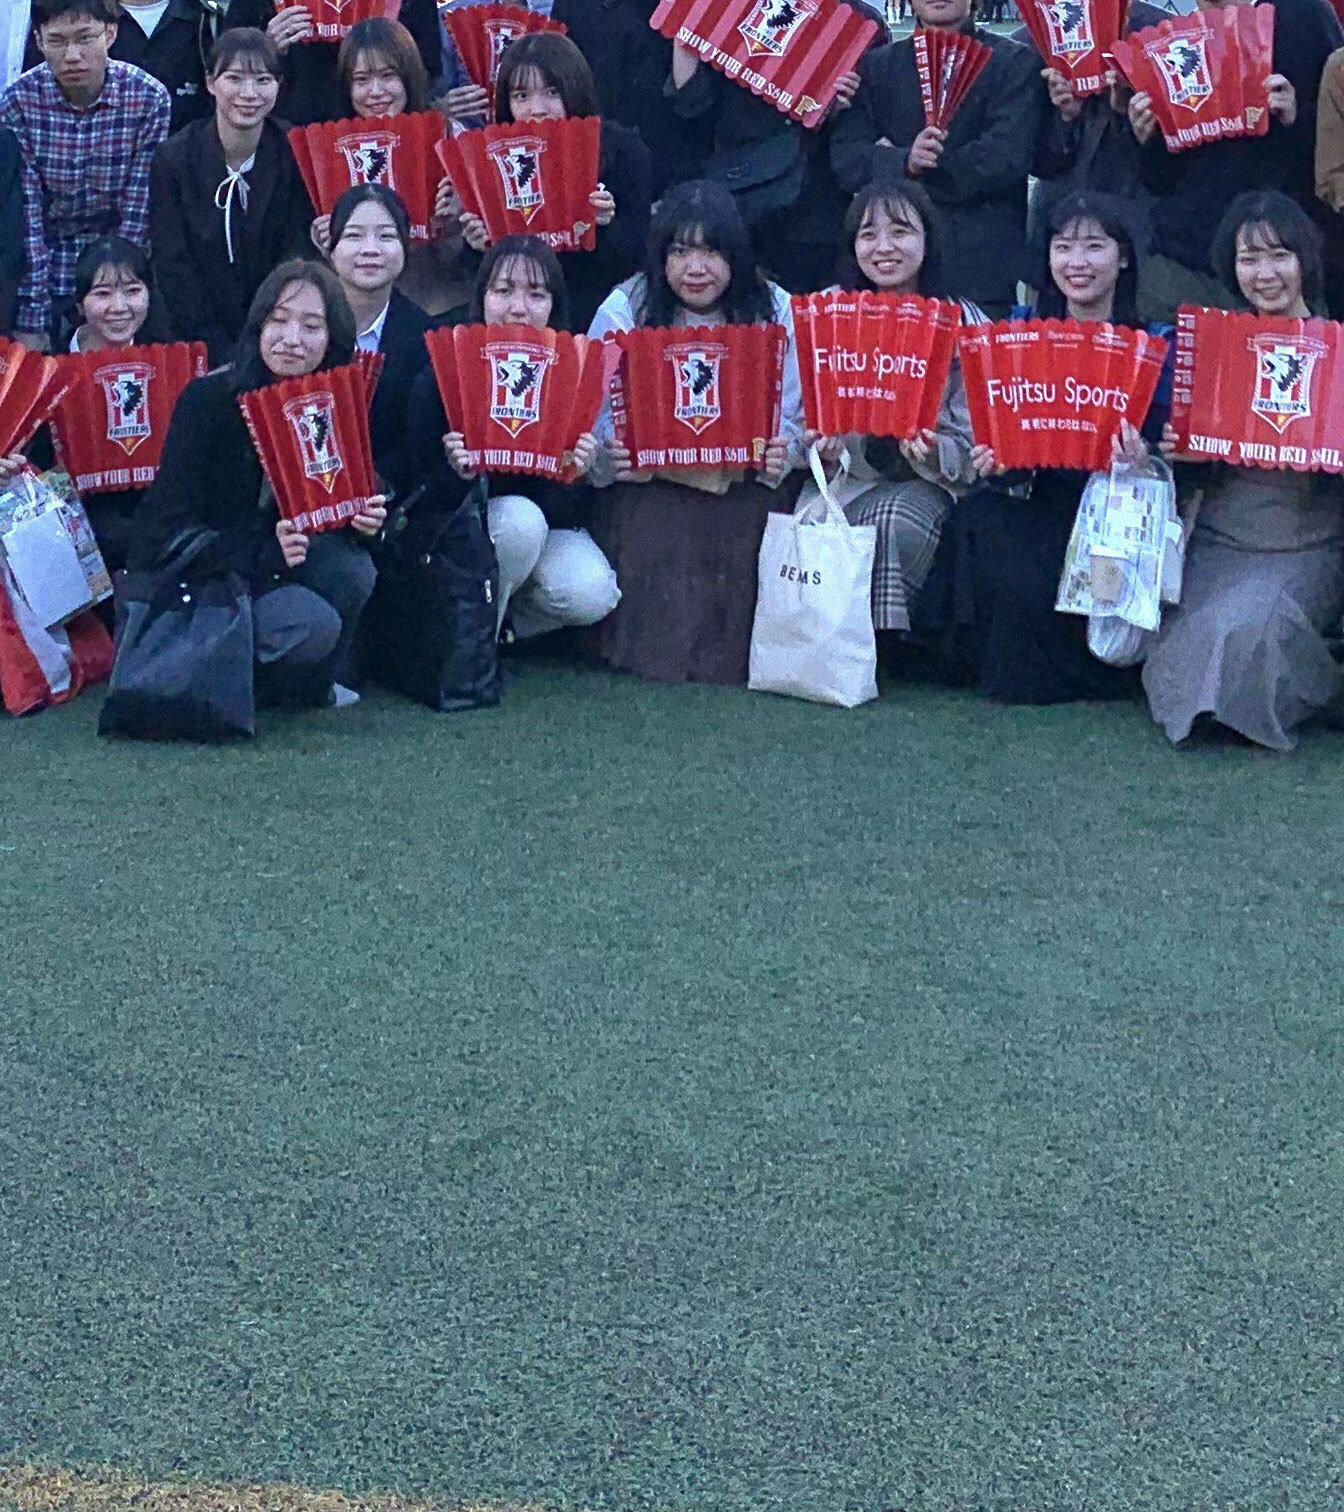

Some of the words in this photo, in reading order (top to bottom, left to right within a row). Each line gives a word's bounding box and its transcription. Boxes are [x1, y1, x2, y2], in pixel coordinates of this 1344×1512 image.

[740, 23, 783, 53] FRONTIERS
[676, 26, 712, 53] SHOW
[710, 44, 743, 74] YOUR
[740, 66, 767, 89] RED
[872, 347, 927, 381] Sports
[987, 376, 1056, 413] Fujitsu
[1064, 376, 1130, 413] Sports
[637, 448, 666, 468] SHOW
[667, 447, 698, 465] YOUR
[700, 447, 723, 464] RED
[1188, 434, 1232, 456] SHOW
[1238, 441, 1277, 461] YOUR
